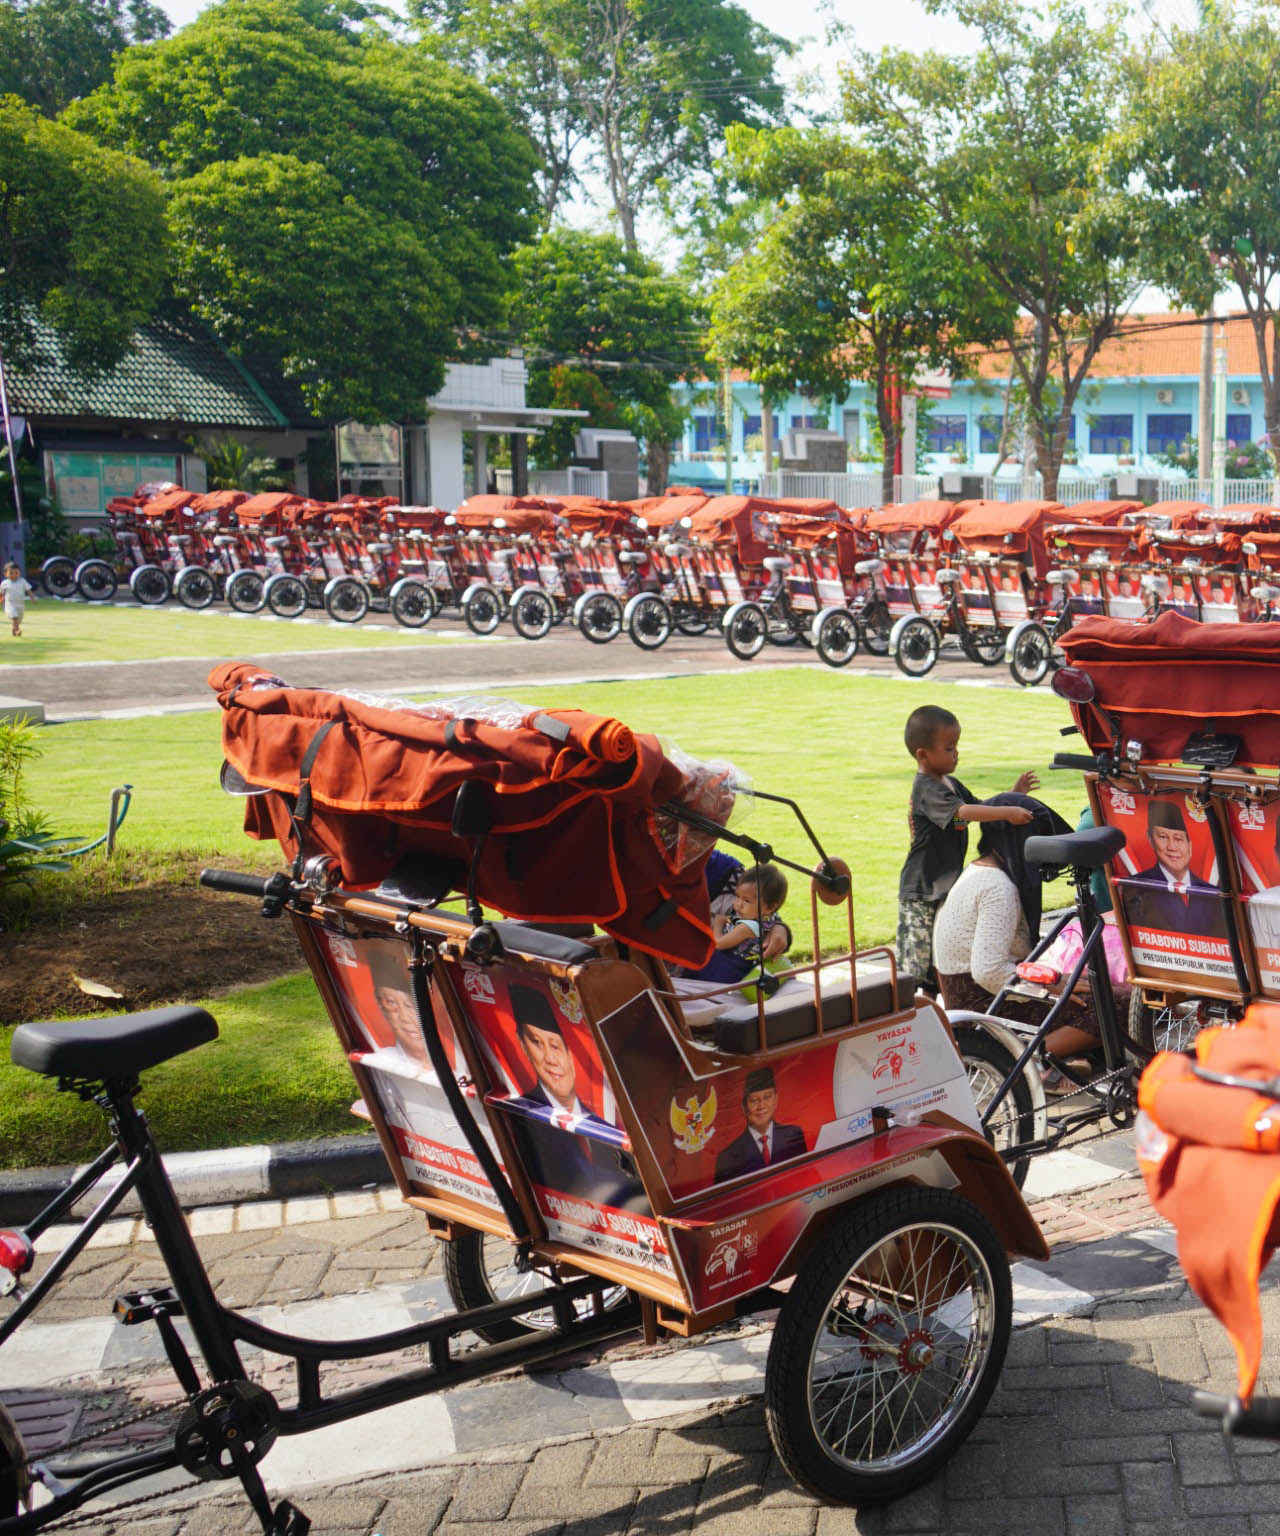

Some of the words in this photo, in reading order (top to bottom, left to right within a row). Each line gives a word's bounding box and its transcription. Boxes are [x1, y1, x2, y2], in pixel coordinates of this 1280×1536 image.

[1138, 931, 1187, 951] PRABOWO
[1188, 939, 1232, 957] SUBIANT
[1143, 952, 1173, 964] PRESIDEN
[1174, 957, 1205, 970] REPUBLIK
[877, 1025, 912, 1042] YAYASAN
[545, 1194, 608, 1228] PRABOWO
[710, 1219, 747, 1238] YAYASAN
